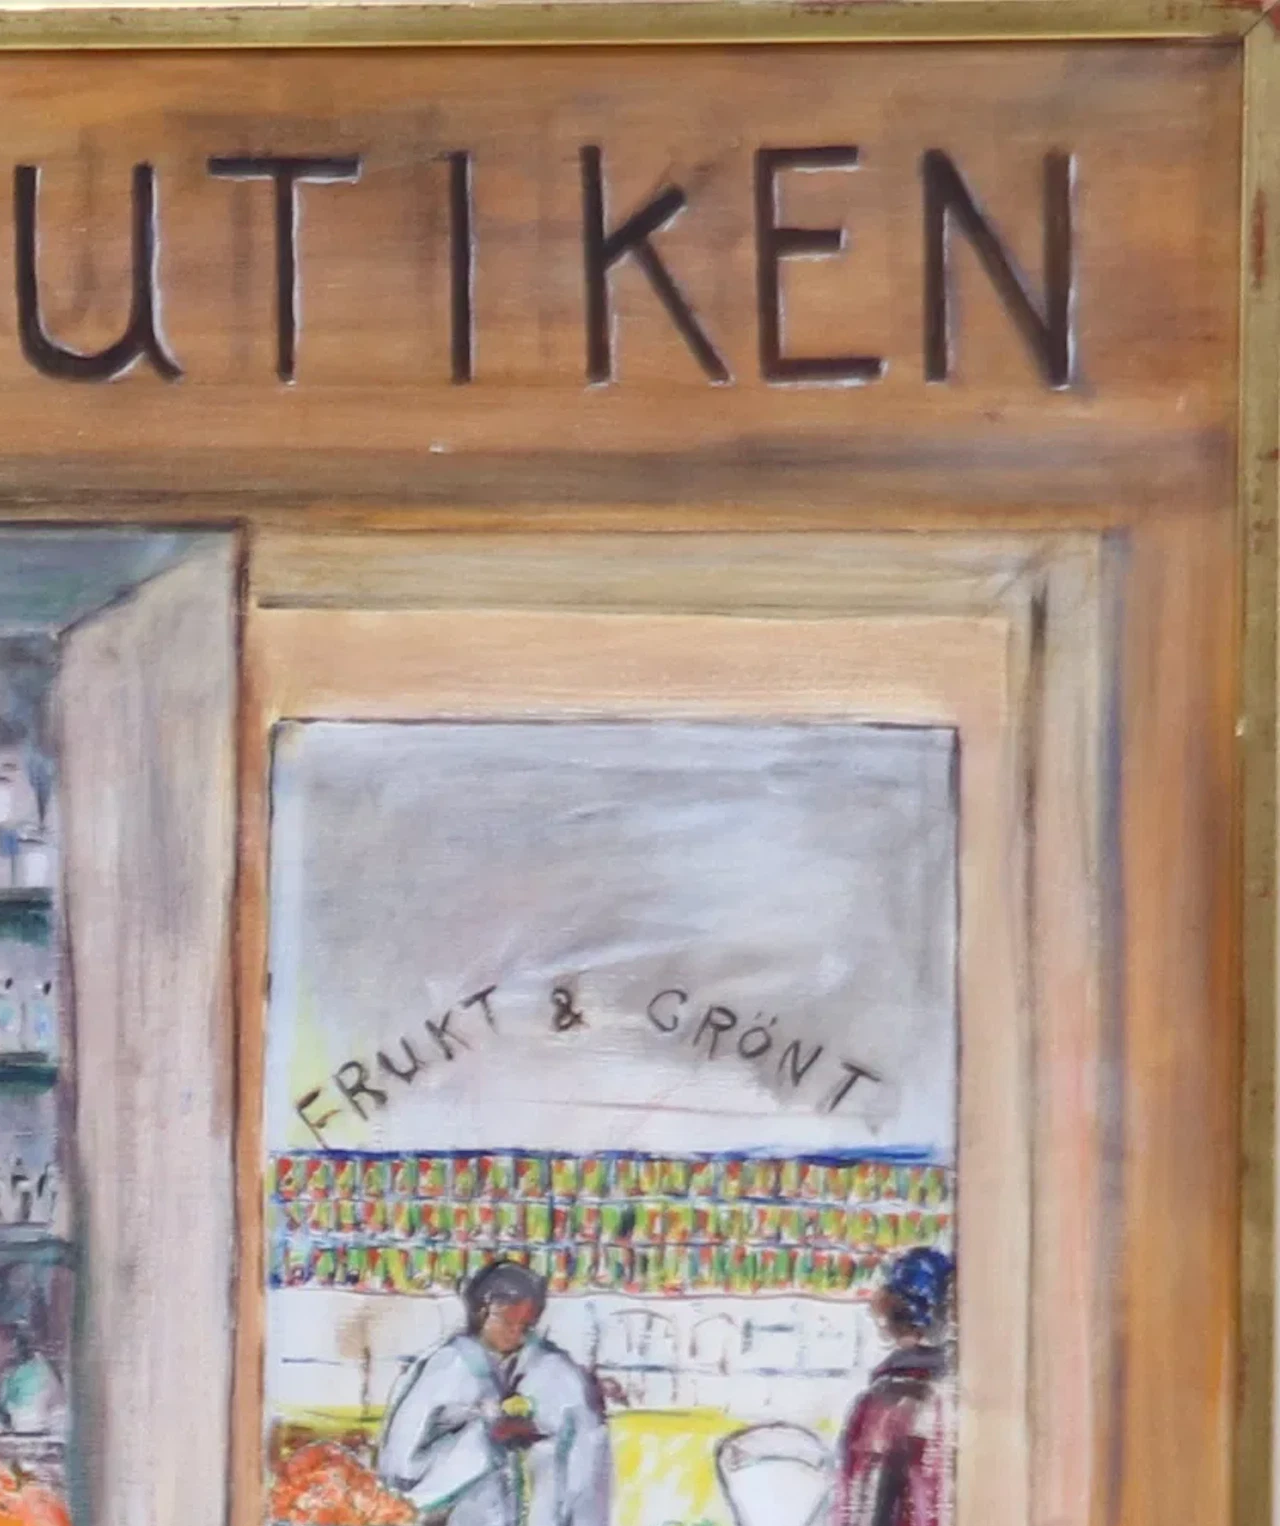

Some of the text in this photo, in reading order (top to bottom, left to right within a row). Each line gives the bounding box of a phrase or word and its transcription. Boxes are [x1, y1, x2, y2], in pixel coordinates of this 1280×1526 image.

[293, 984, 883, 1151] FRUKT & GRÖNT
